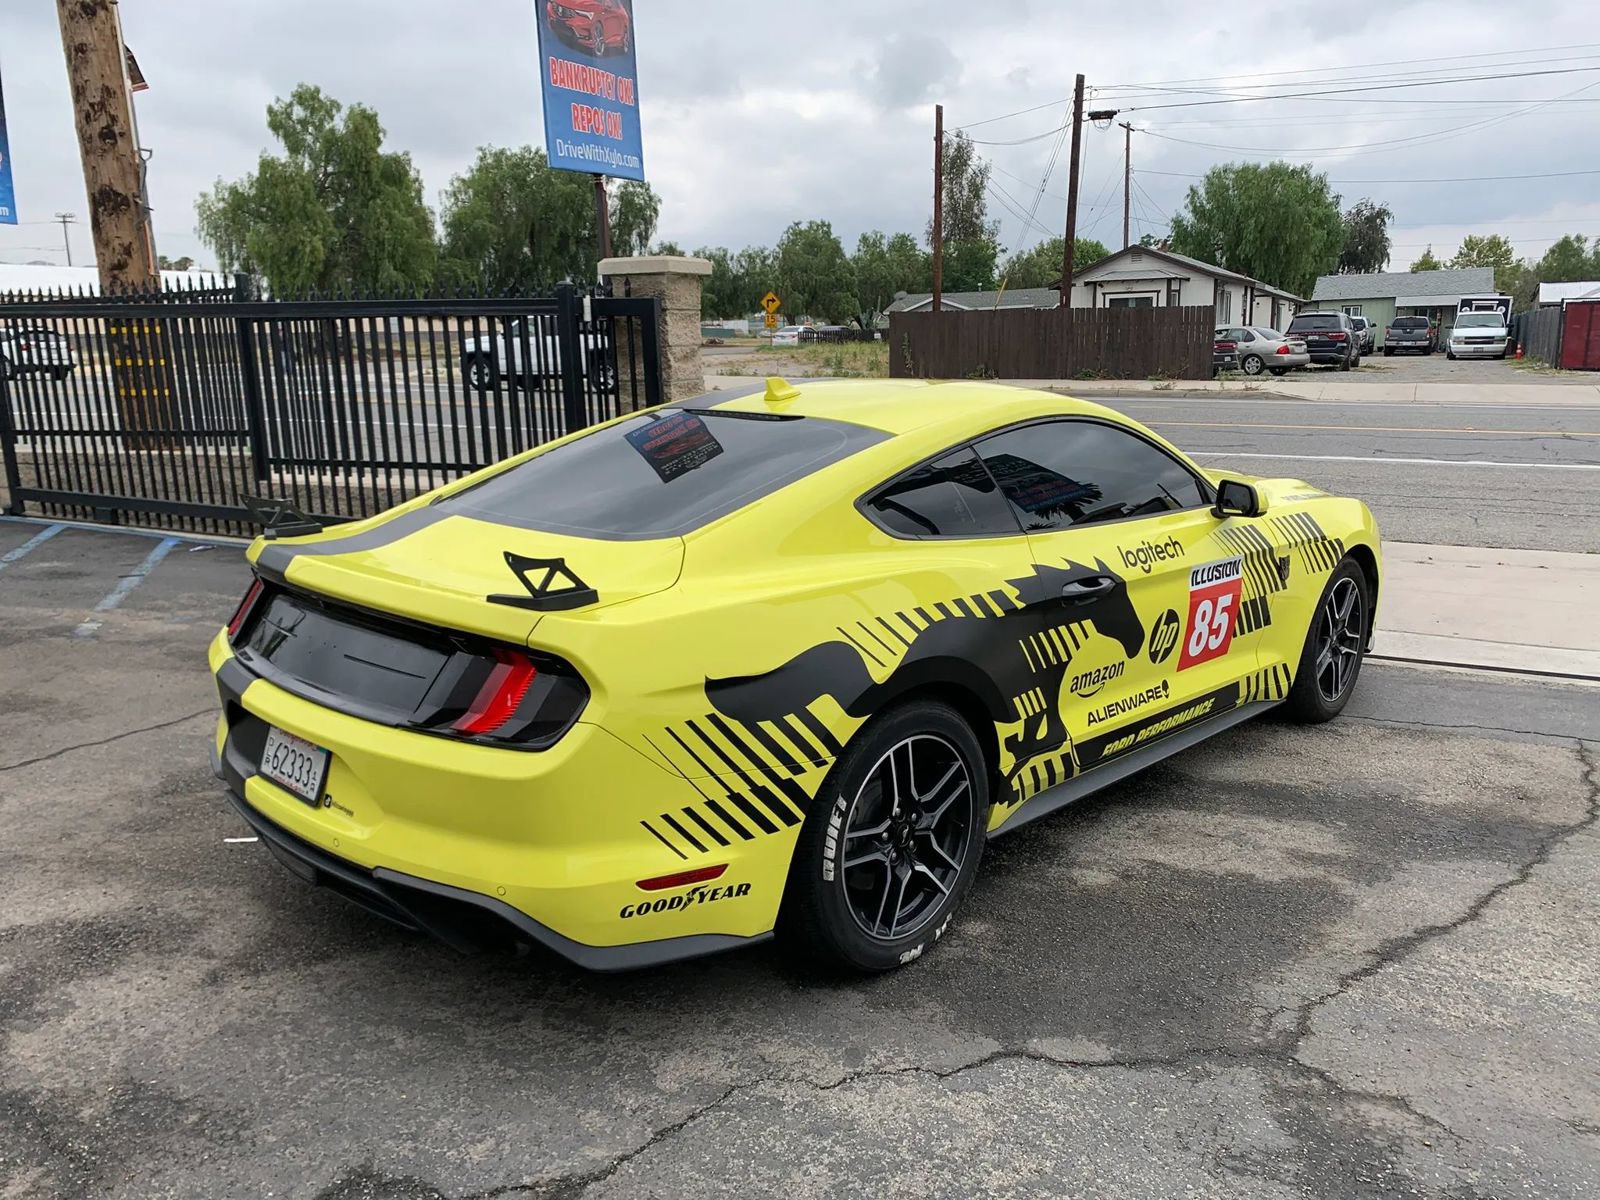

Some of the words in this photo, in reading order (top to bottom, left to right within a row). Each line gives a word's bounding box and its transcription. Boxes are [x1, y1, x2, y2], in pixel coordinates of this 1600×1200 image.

[549, 57, 615, 100] BANKRUPTCY
[617, 76, 635, 106] OK!
[571, 103, 605, 136] REPOS
[607, 111, 623, 139] OK!
[556, 139, 640, 168] DriveWithXylo.com
[1117, 536, 1185, 573] logitech
[1191, 558, 1242, 587] ILLUSION
[1150, 609, 1180, 664] hp
[1188, 593, 1234, 657] 85
[1070, 660, 1125, 695] amazon
[1087, 684, 1162, 727] ALIENWARE
[1099, 733, 1136, 759] FORD
[1134, 698, 1216, 744] PERFORMANCE
[272, 742, 313, 787] 62333
[620, 882, 752, 919] GOODYEAR
